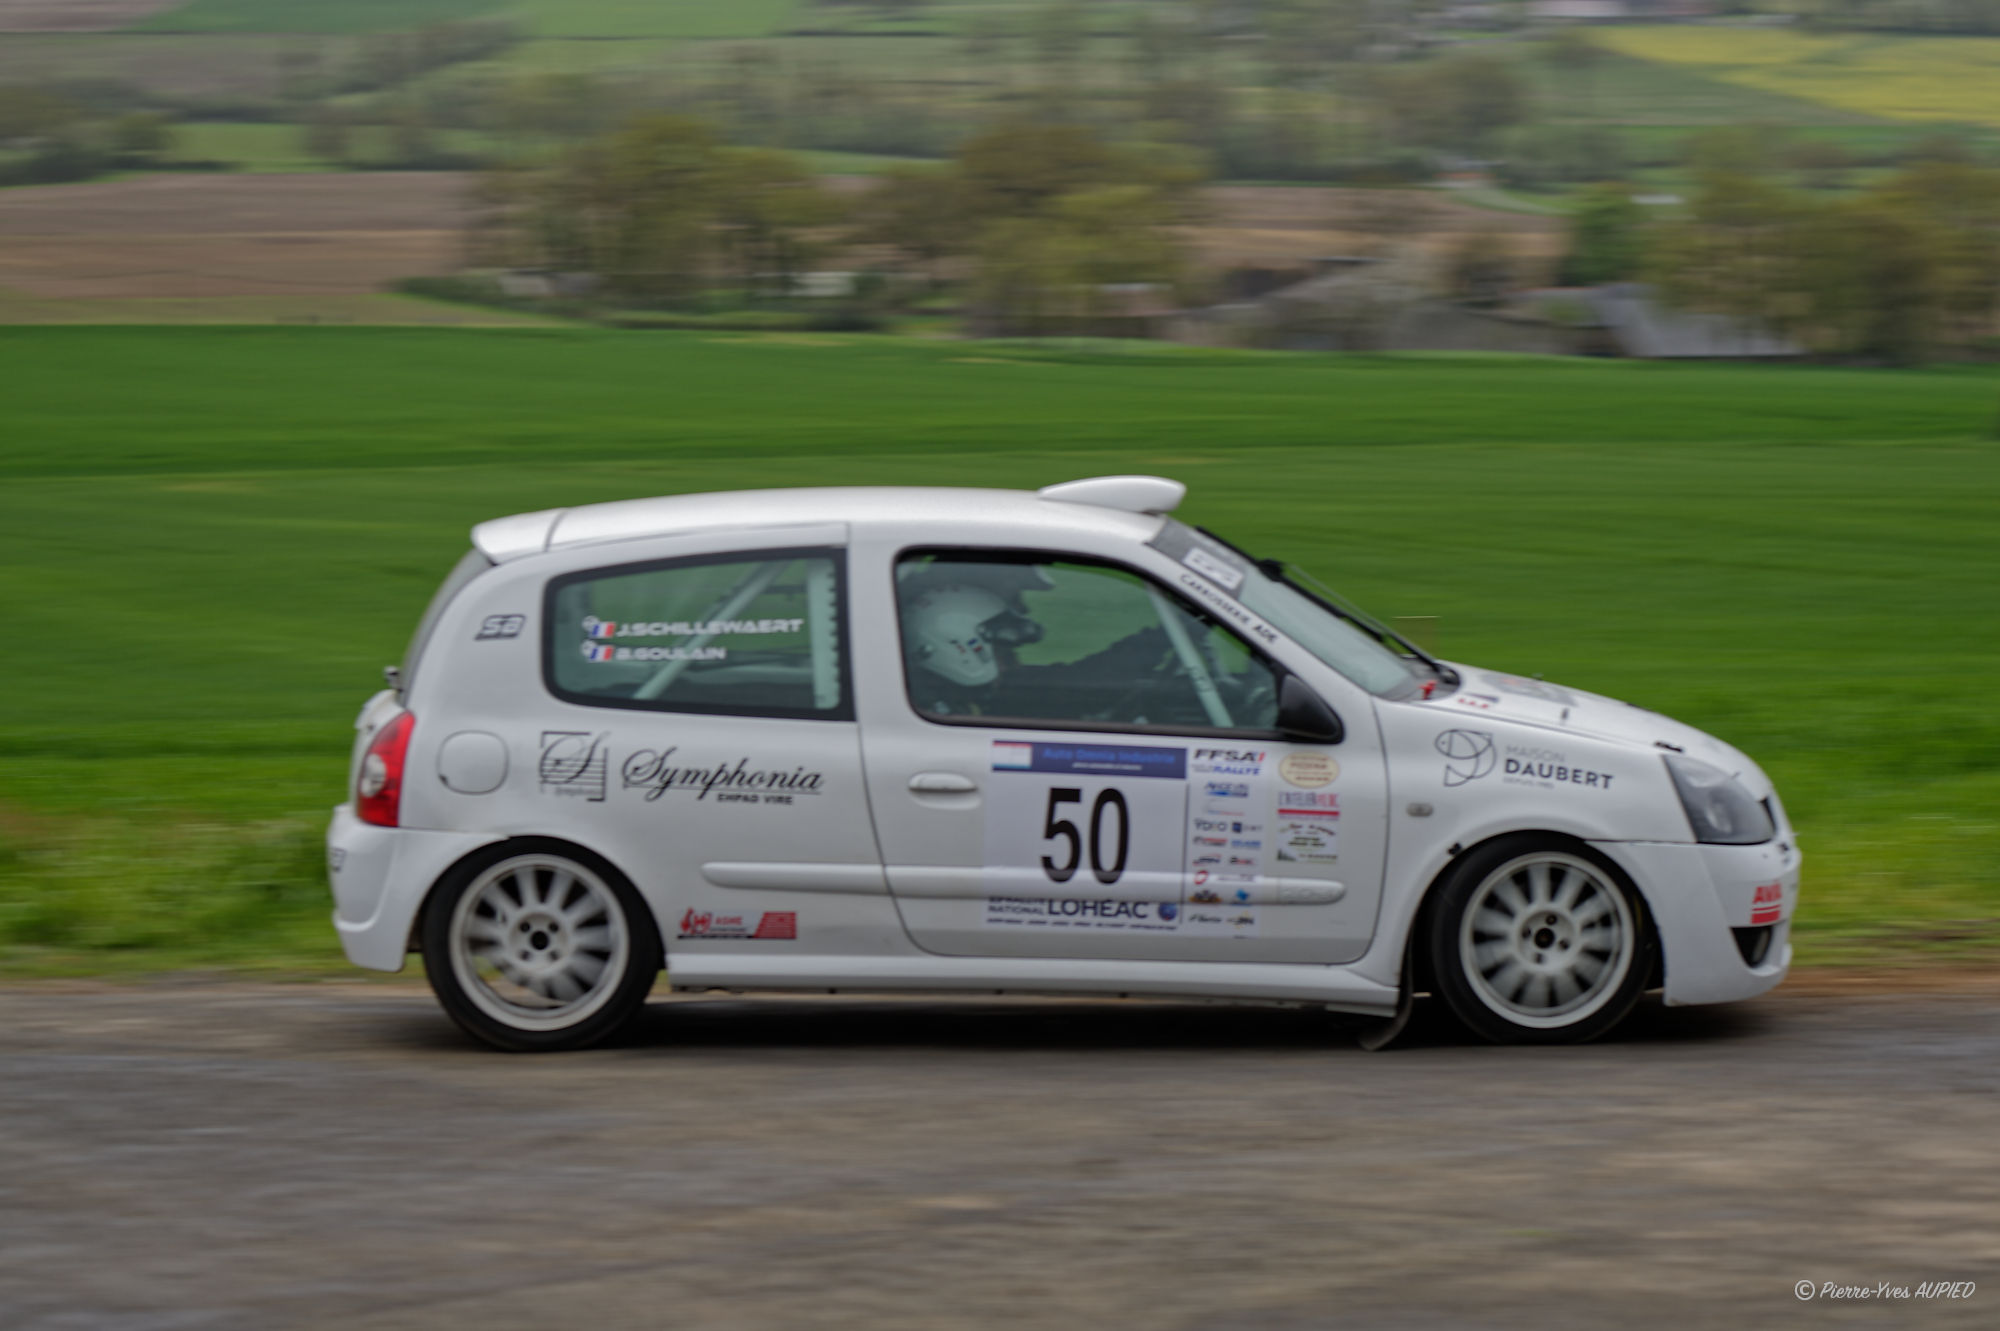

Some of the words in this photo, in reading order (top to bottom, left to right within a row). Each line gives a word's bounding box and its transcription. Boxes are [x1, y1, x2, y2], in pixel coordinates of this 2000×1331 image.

[1505, 746, 1567, 762] MAISON
[621, 746, 825, 802] Symphonia
[1504, 758, 1613, 790] DAUBERT
[1041, 787, 1130, 883] 50
[987, 903, 1045, 915] NATIONAL
